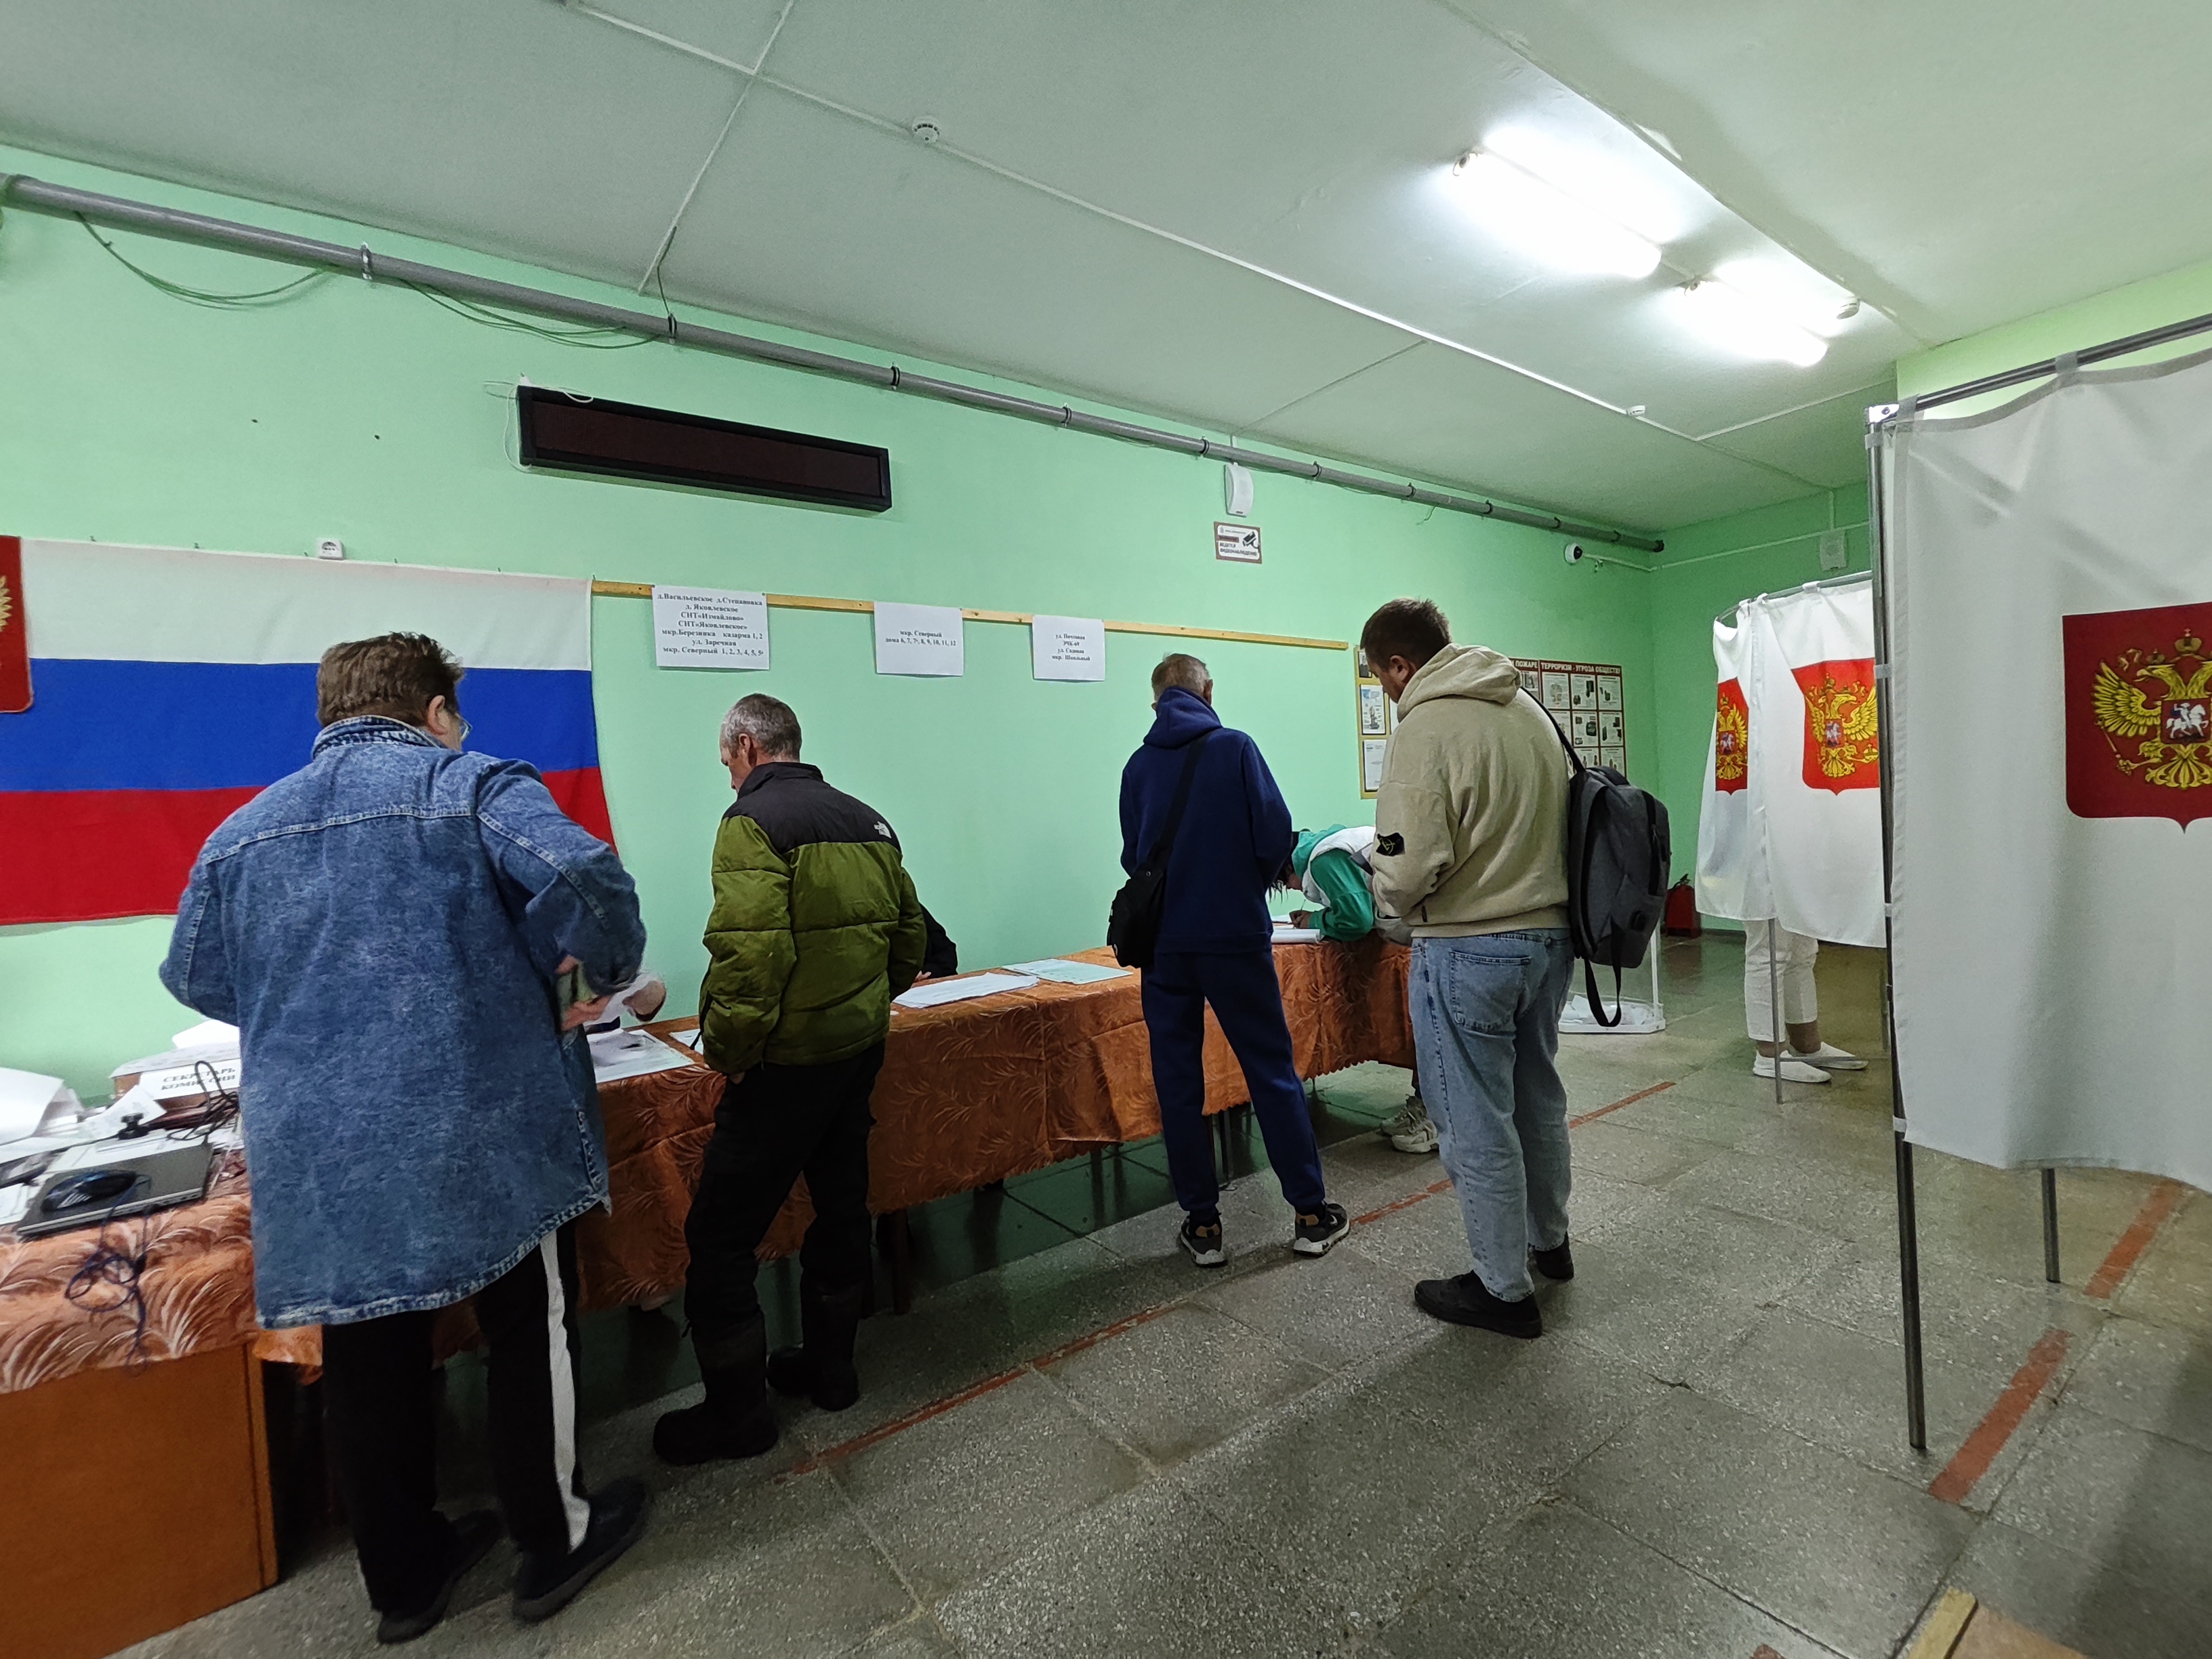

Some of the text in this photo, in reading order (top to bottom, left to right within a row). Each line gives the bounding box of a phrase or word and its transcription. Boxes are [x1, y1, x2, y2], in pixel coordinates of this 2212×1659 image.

[657, 593, 763, 606] д.Васильевское д.Степановка
[694, 604, 739, 613] Яковлевское
[681, 612, 744, 621] СНТ«Измайлово»
[678, 621, 747, 630] СНТ«Яковлевское»
[682, 647, 718, 655] Северный
[1515, 660, 1538, 668] ПОЖАРЕ
[1540, 662, 1572, 671] ТЕРРОРИЗМ
